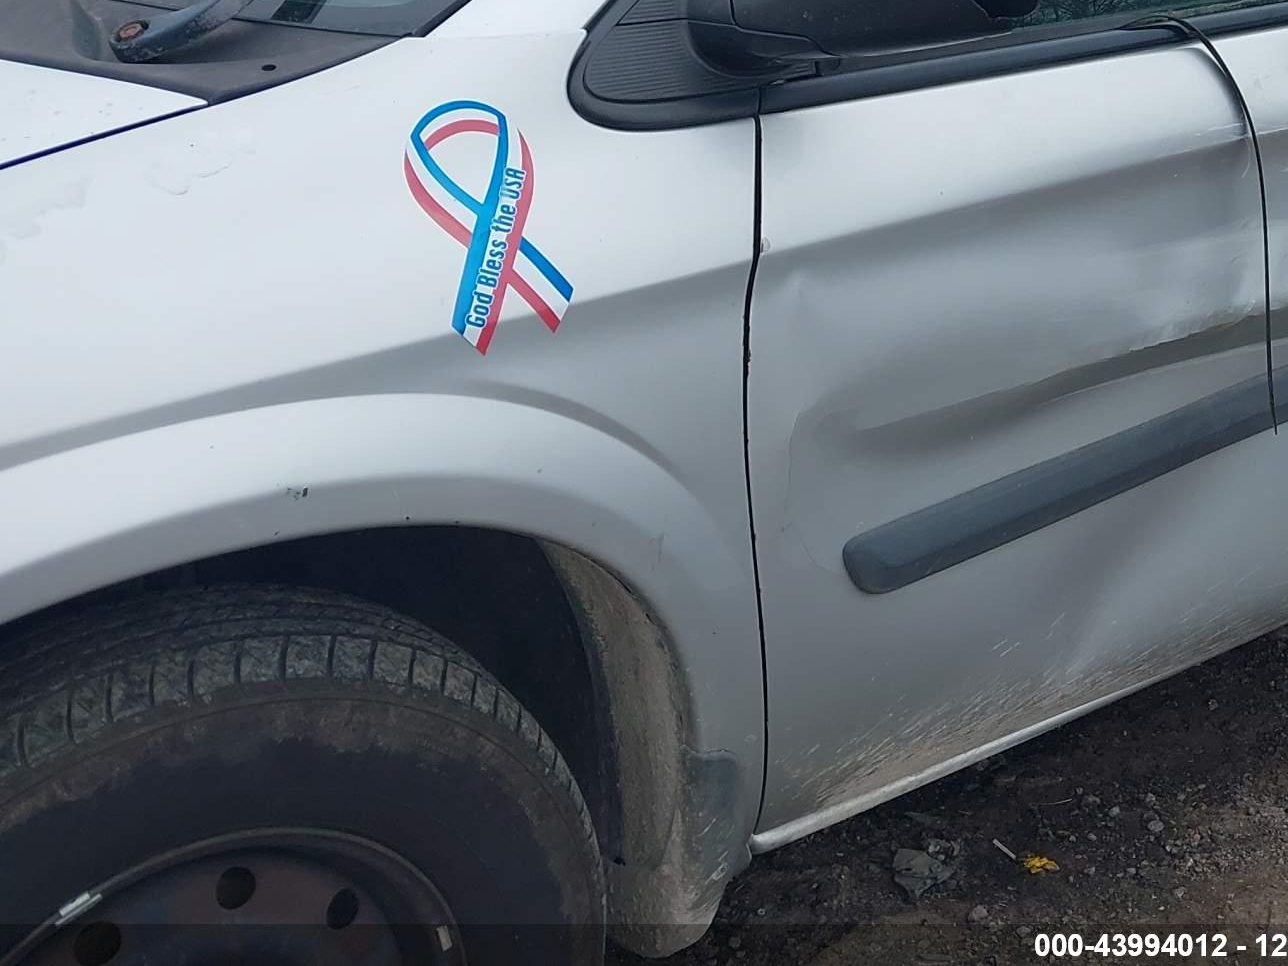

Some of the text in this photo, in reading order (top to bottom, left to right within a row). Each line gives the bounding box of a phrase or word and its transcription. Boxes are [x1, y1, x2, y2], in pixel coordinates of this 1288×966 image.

[466, 167, 526, 328] God Bless the USA
